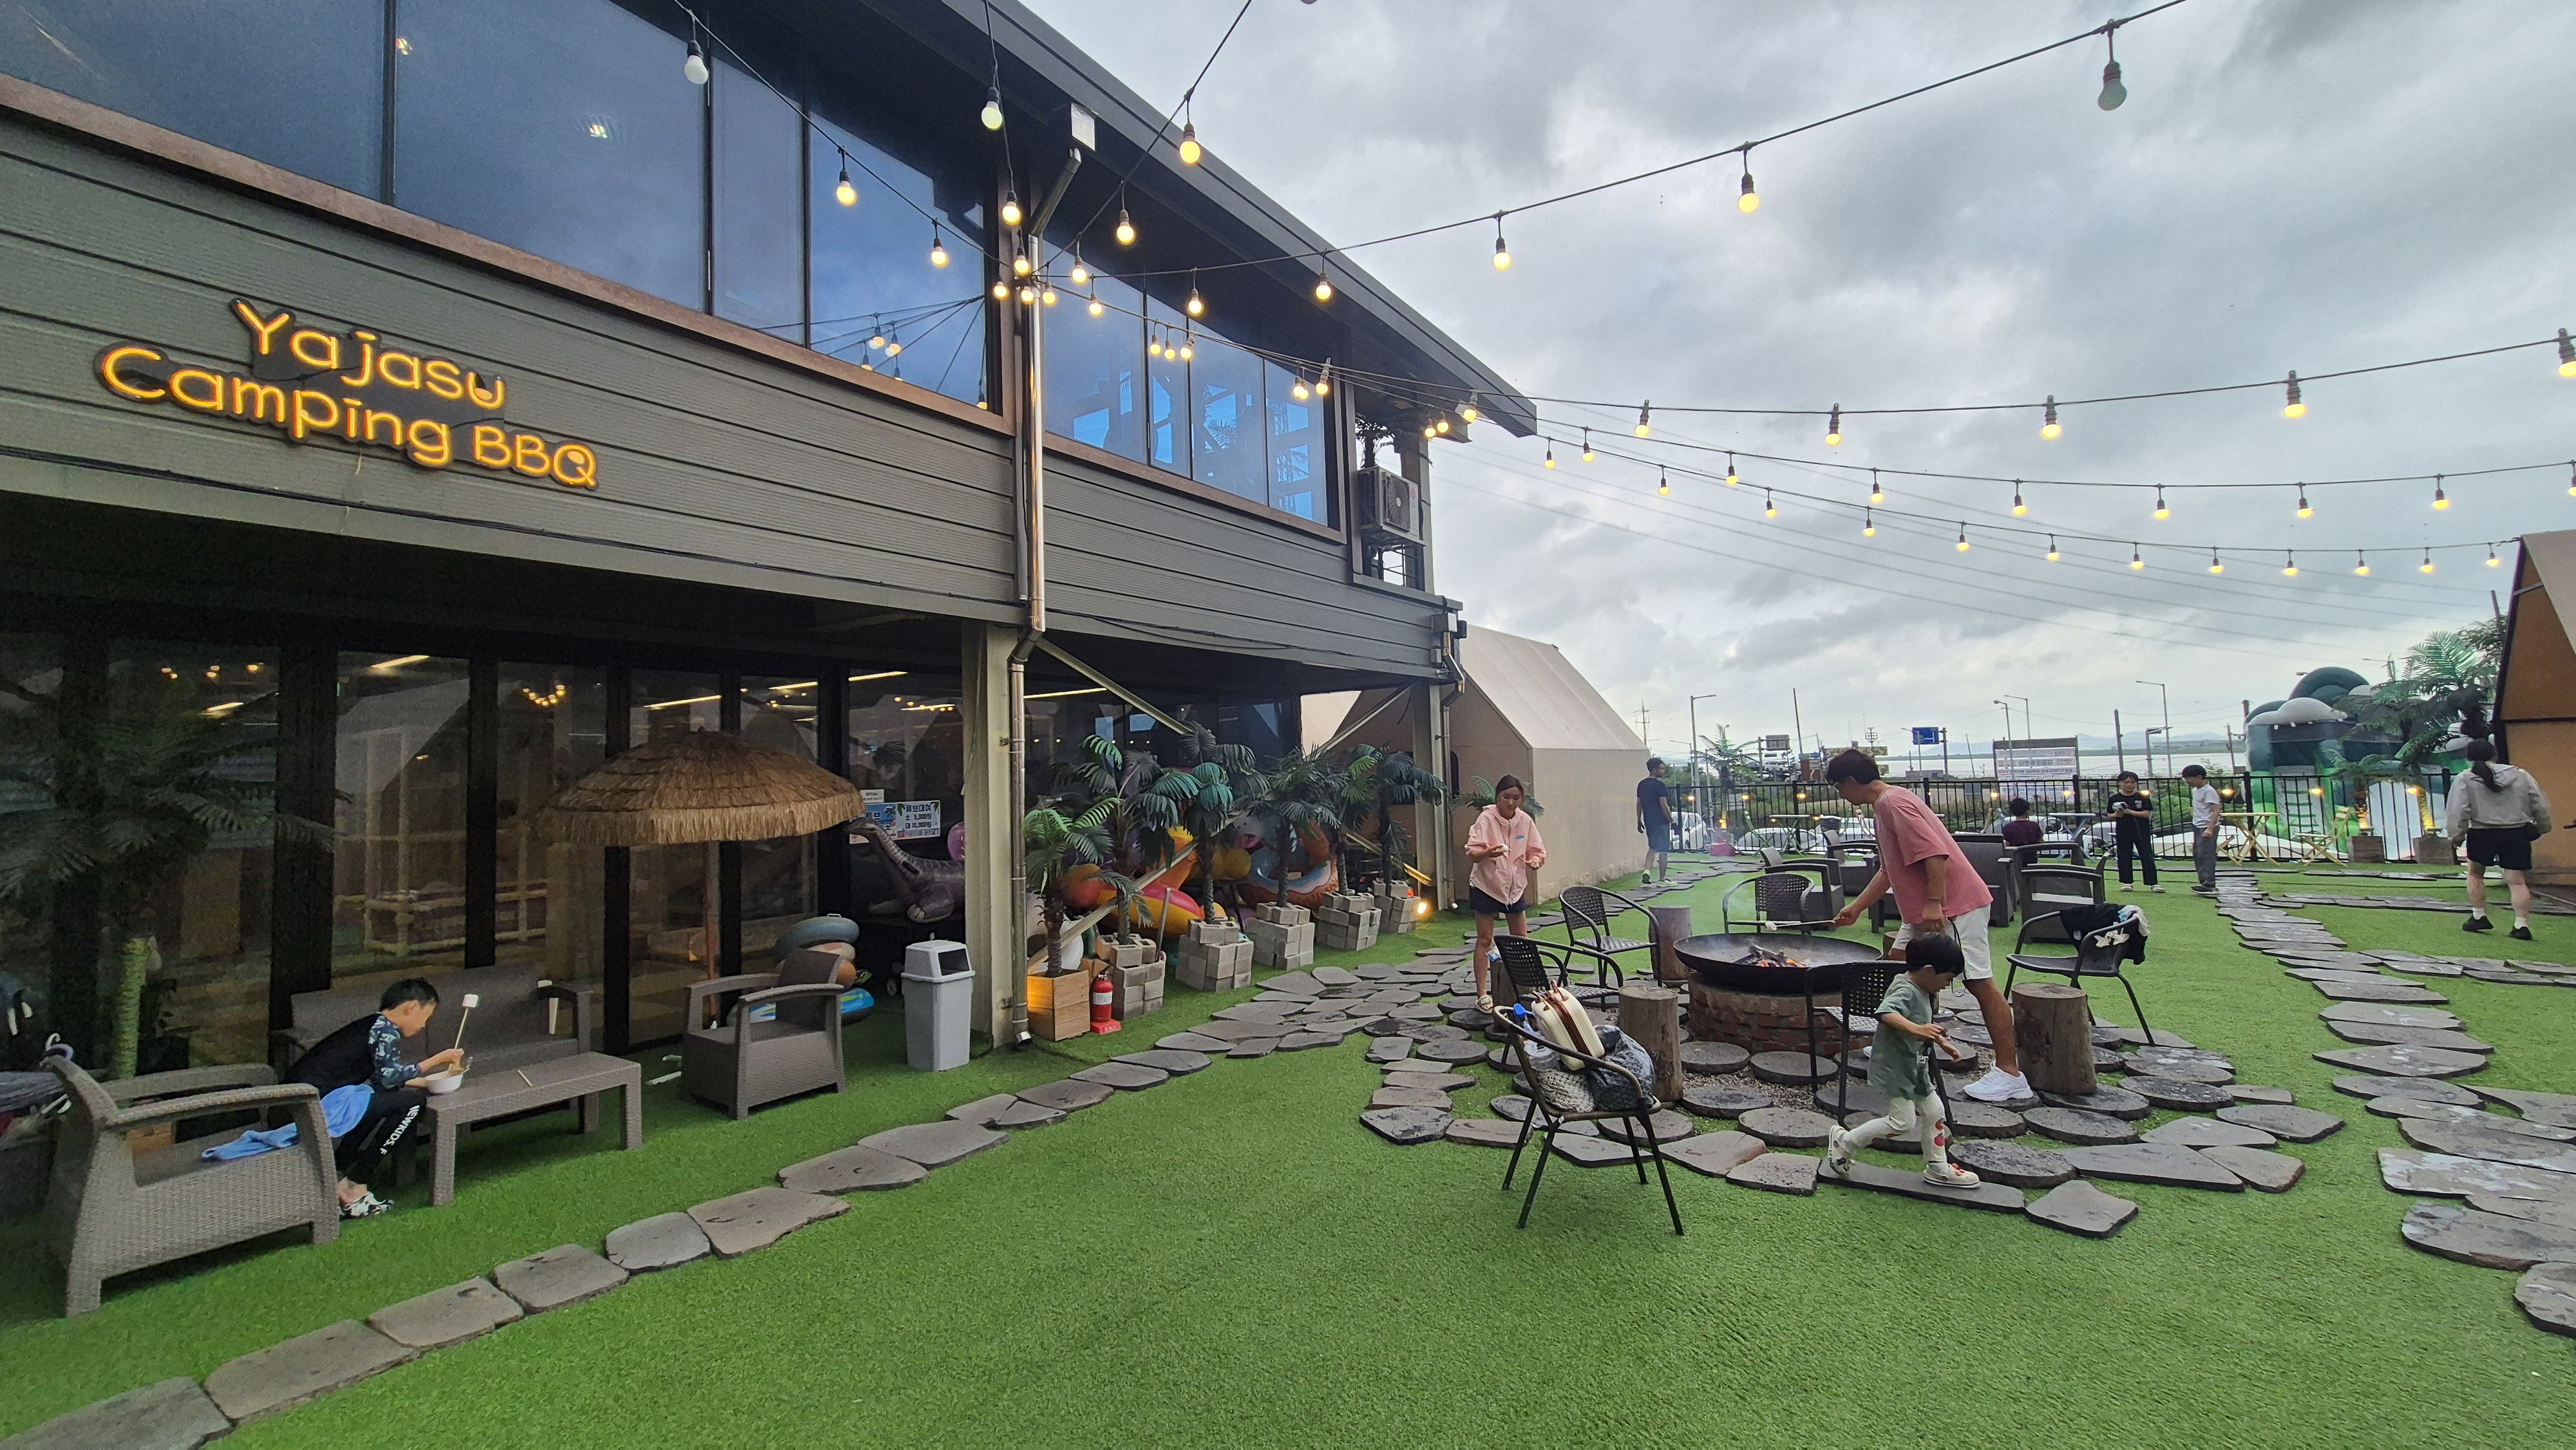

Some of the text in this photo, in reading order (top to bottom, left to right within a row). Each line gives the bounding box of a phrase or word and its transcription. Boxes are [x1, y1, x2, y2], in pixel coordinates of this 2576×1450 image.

[236, 301, 506, 410] Yajasu
[103, 345, 596, 487] Camping BBQ
[906, 804, 931, 813] 튜브대여
